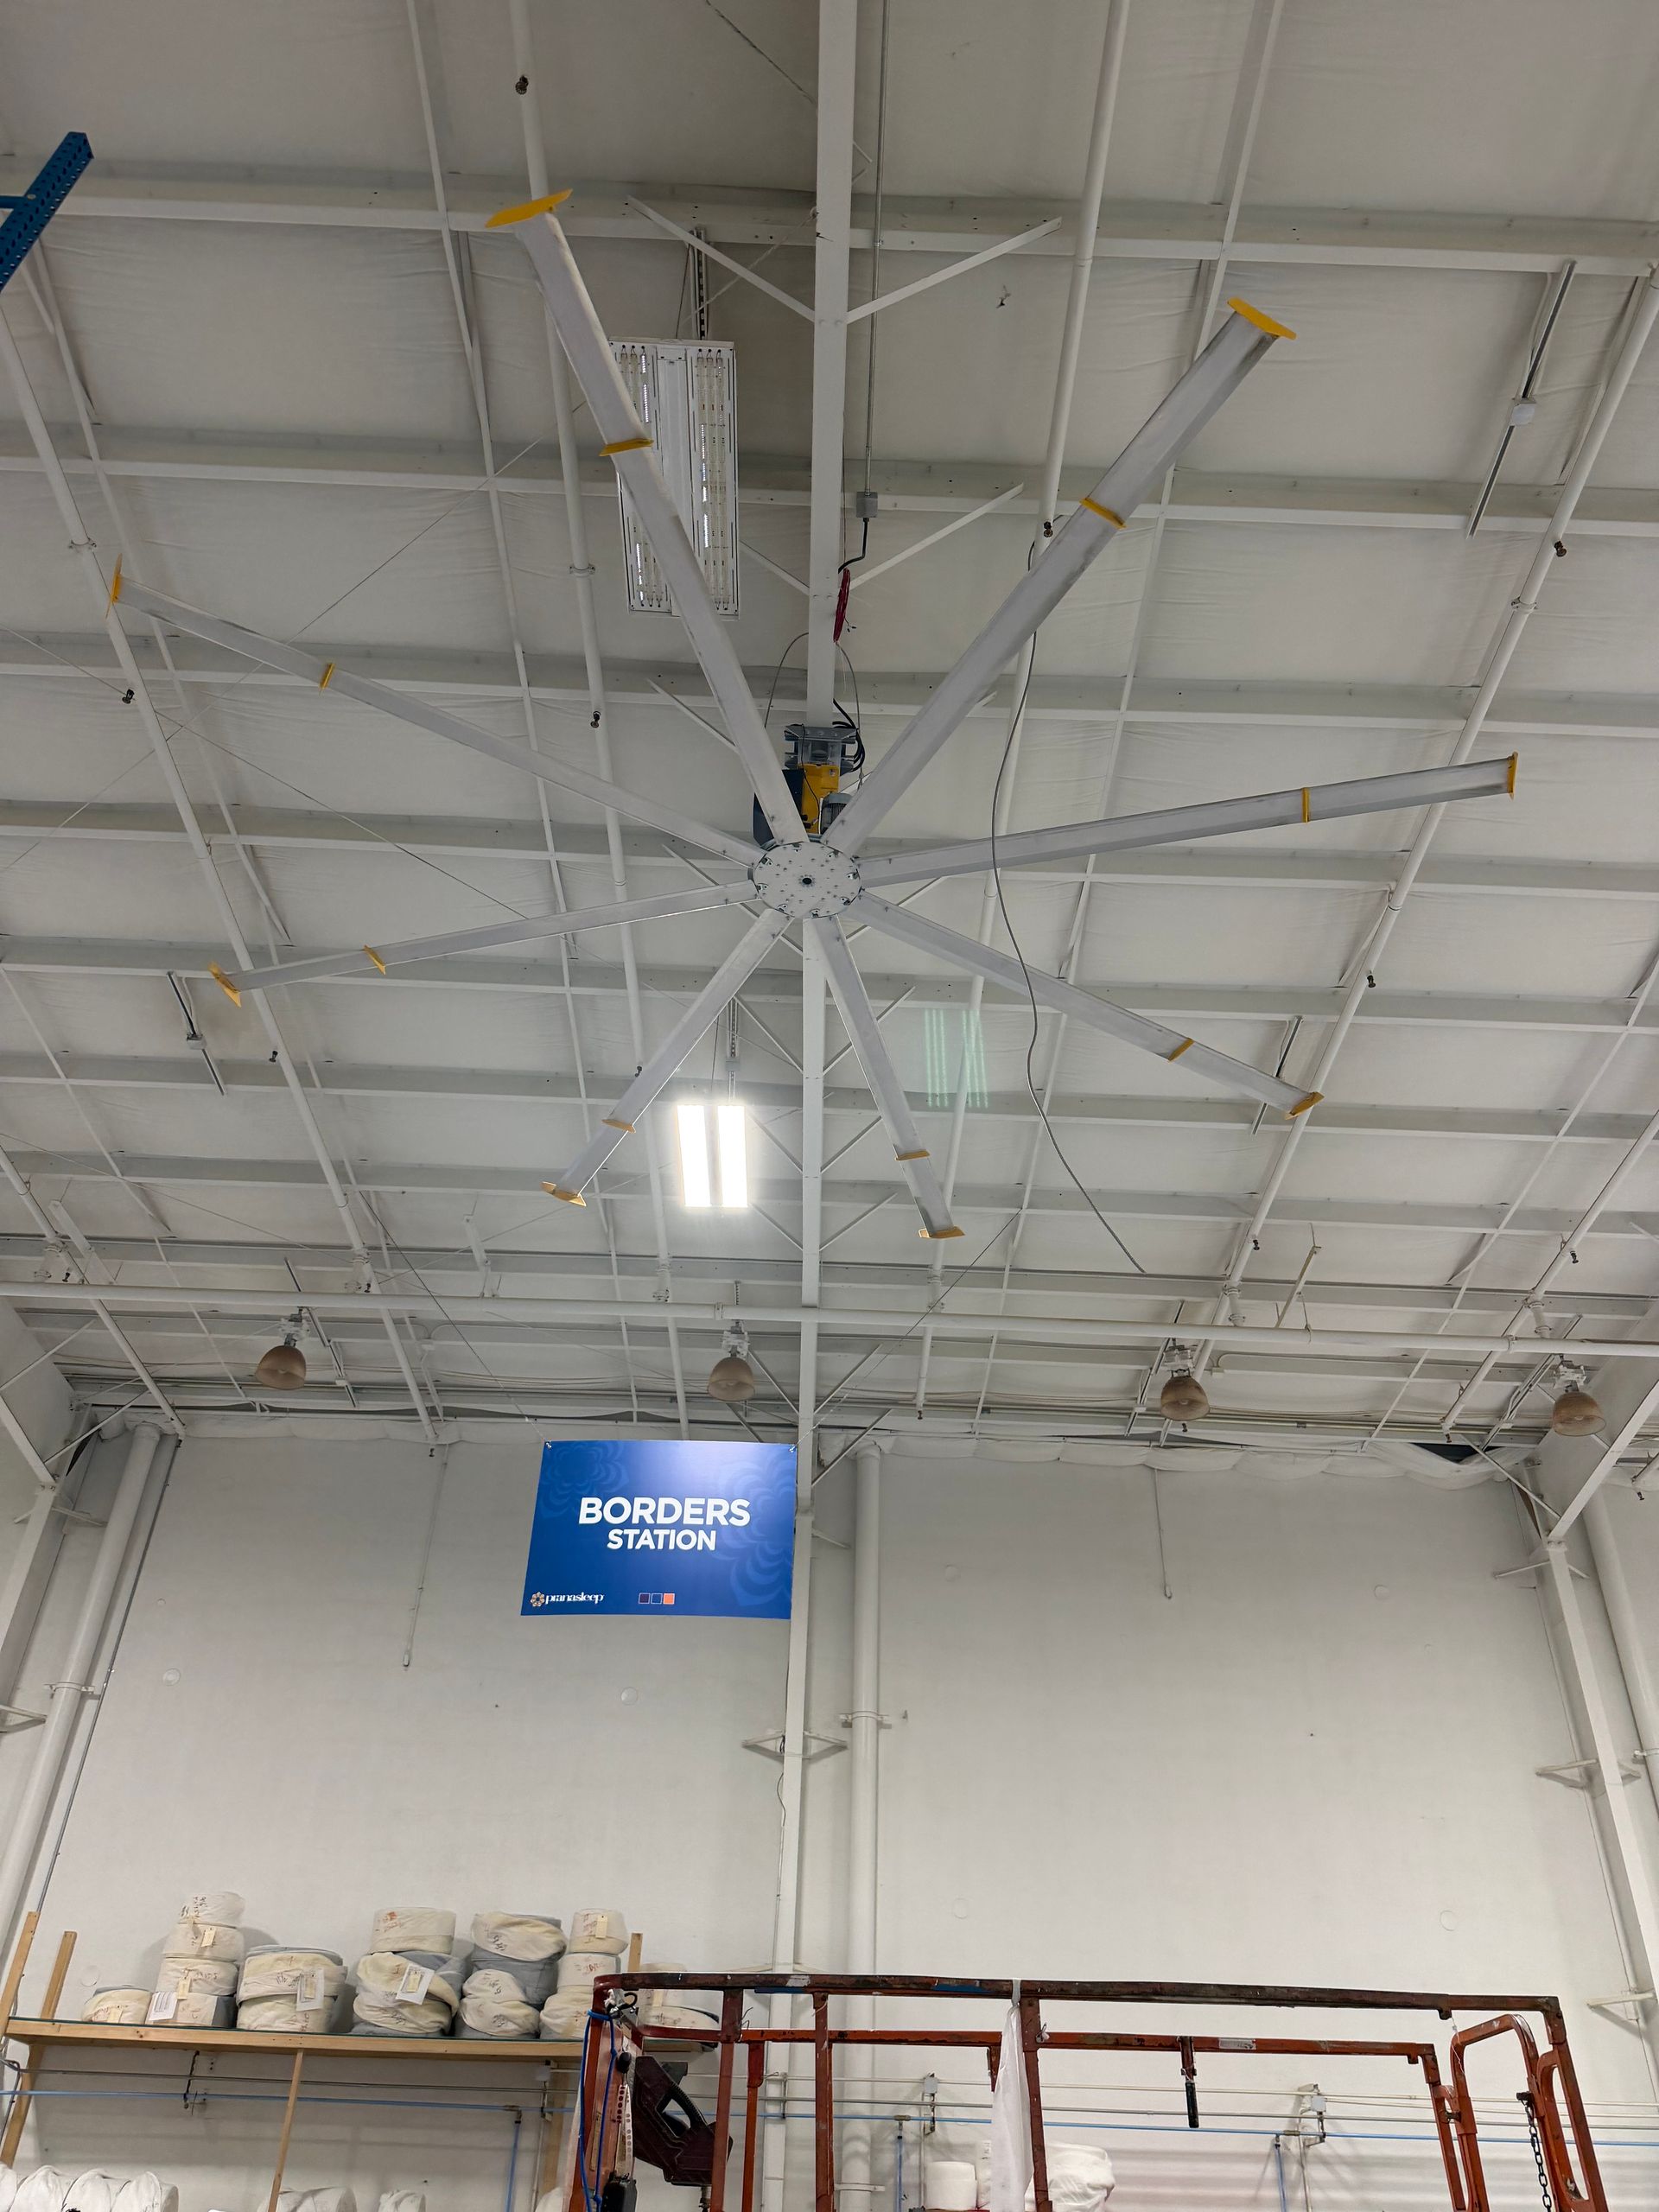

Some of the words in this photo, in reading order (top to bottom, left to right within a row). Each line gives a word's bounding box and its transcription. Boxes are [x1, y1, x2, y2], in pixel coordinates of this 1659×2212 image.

[579, 1497, 751, 1526] BORDERS
[607, 1529, 716, 1551] STATION
[545, 1592, 604, 1605] pranasleep
